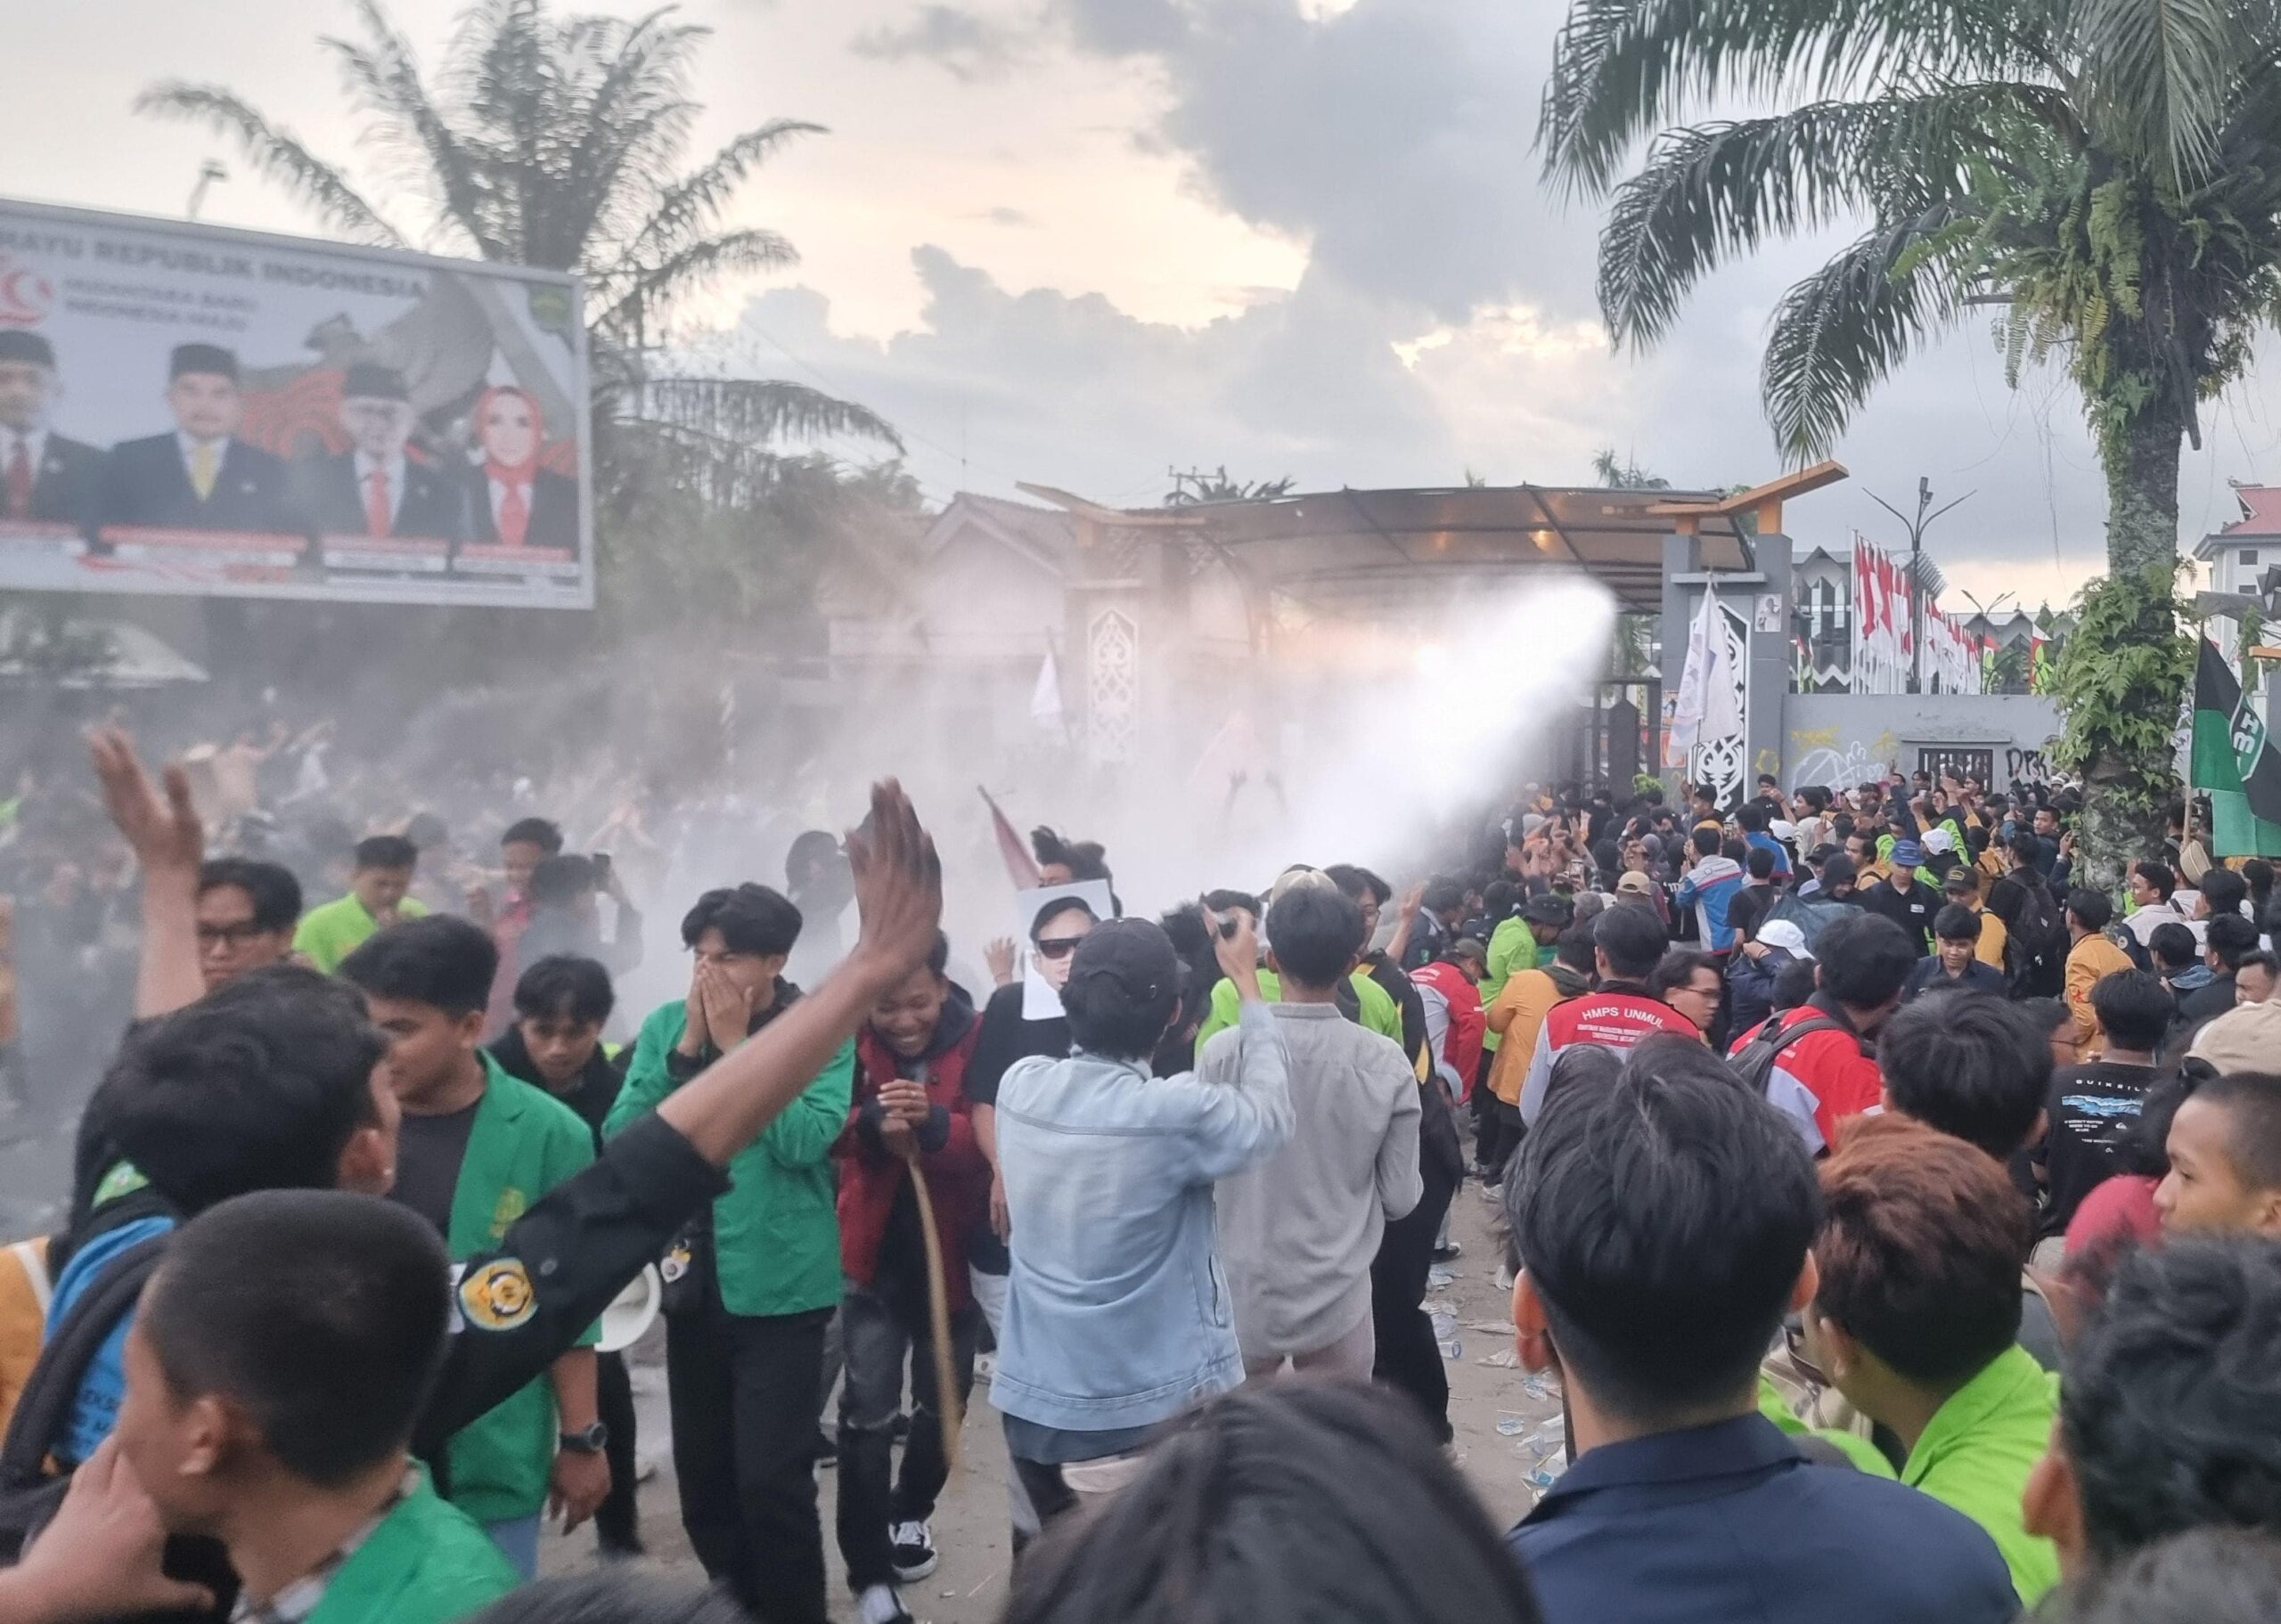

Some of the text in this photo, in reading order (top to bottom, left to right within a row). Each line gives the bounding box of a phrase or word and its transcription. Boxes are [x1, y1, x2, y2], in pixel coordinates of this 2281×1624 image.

[94, 240, 253, 278] REPUBLIK
[264, 262, 427, 298] INDONESIA
[1582, 1007, 1664, 1029] HMPS UNMUL
